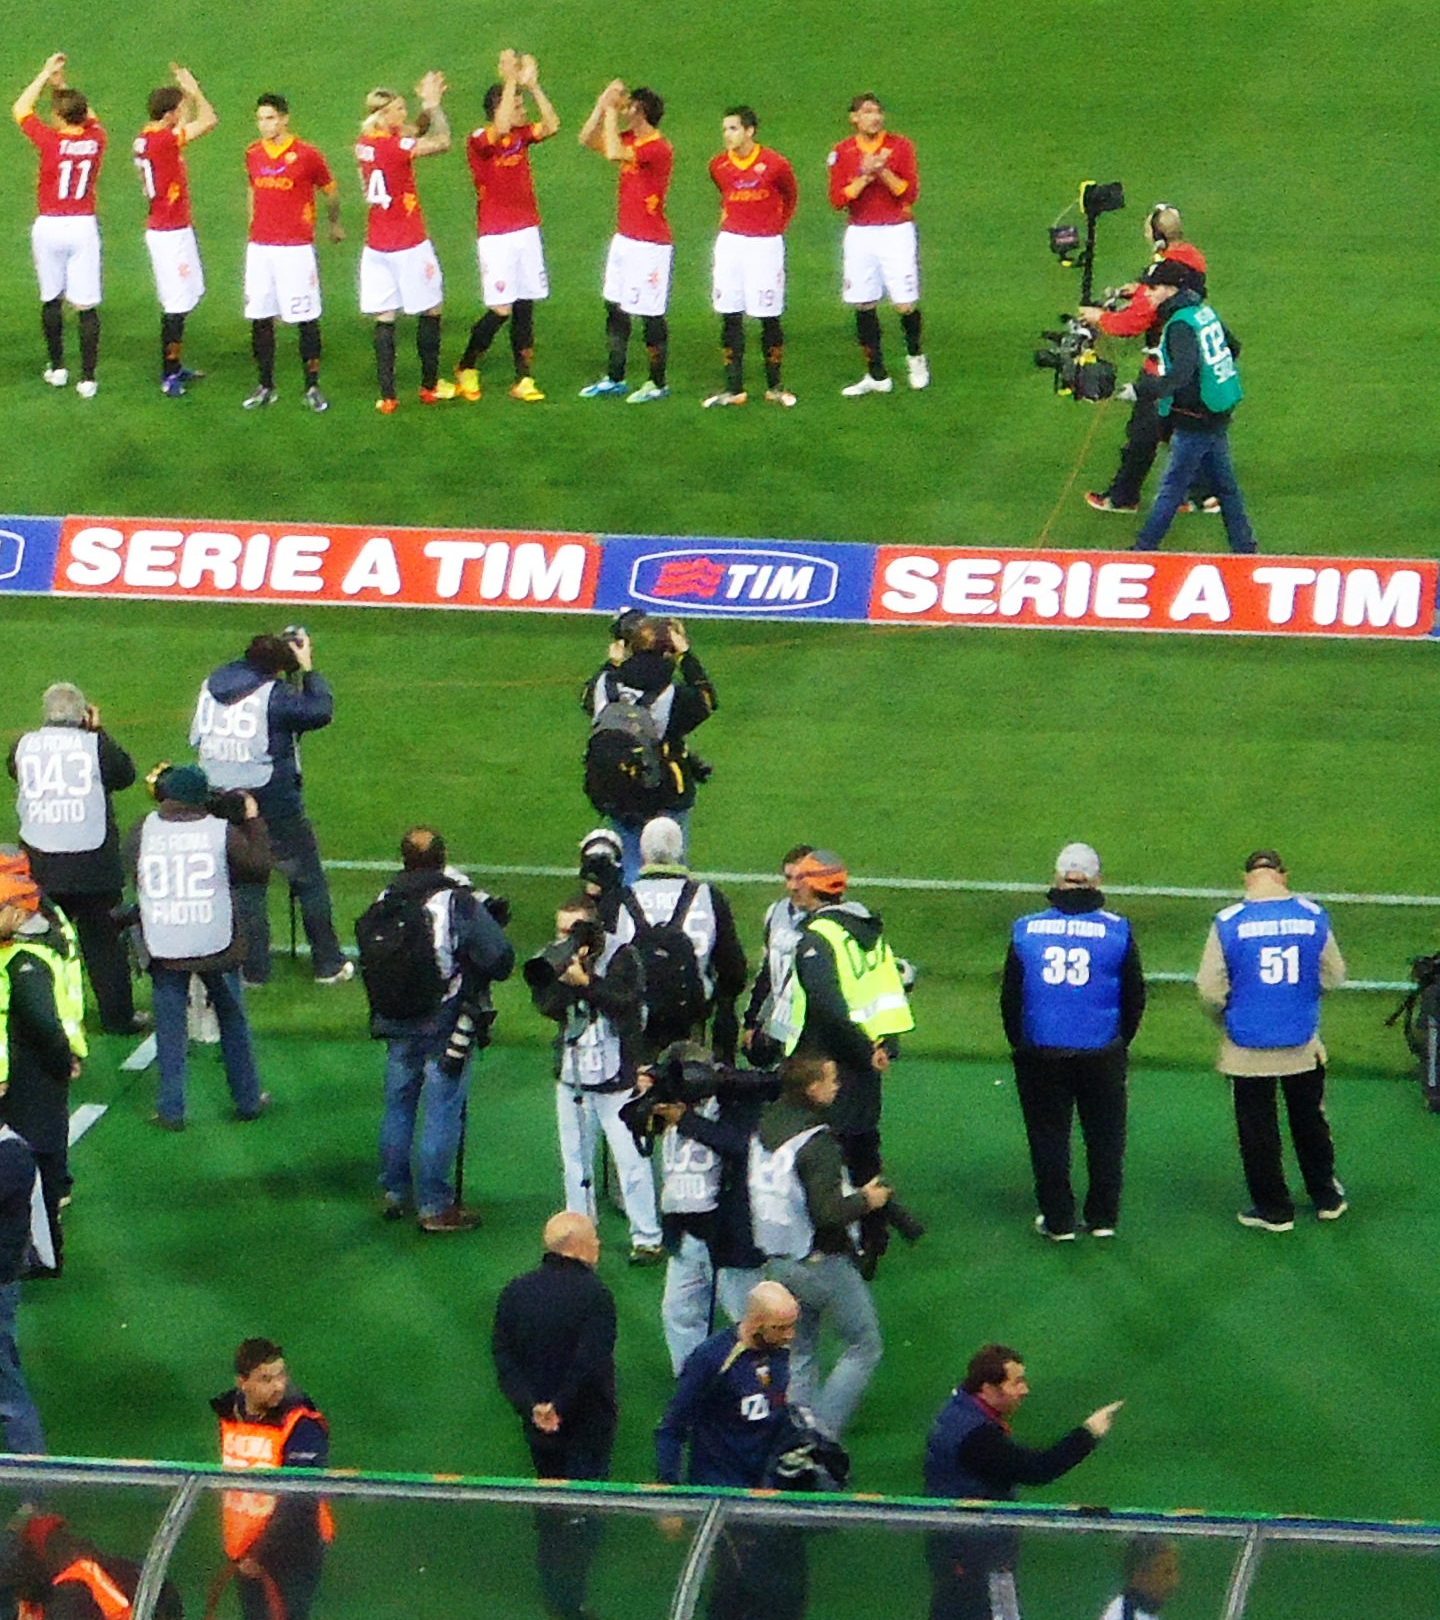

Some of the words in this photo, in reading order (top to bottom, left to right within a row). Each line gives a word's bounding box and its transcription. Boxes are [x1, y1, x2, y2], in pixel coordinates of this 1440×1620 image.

[58, 159, 93, 200] 11
[65, 527, 334, 590] SERIE
[341, 536, 403, 597] A
[423, 539, 588, 602] TIM
[724, 562, 814, 602] TIM
[880, 555, 1155, 620] SERIE
[1167, 564, 1232, 623] A
[1251, 565, 1423, 629] TIM
[19, 751, 93, 800] 043
[28, 800, 85, 824] PHOTO
[142, 852, 216, 899] 012
[151, 900, 213, 925] PHOTO
[1042, 945, 1091, 986] 33
[1259, 944, 1299, 984] 51
